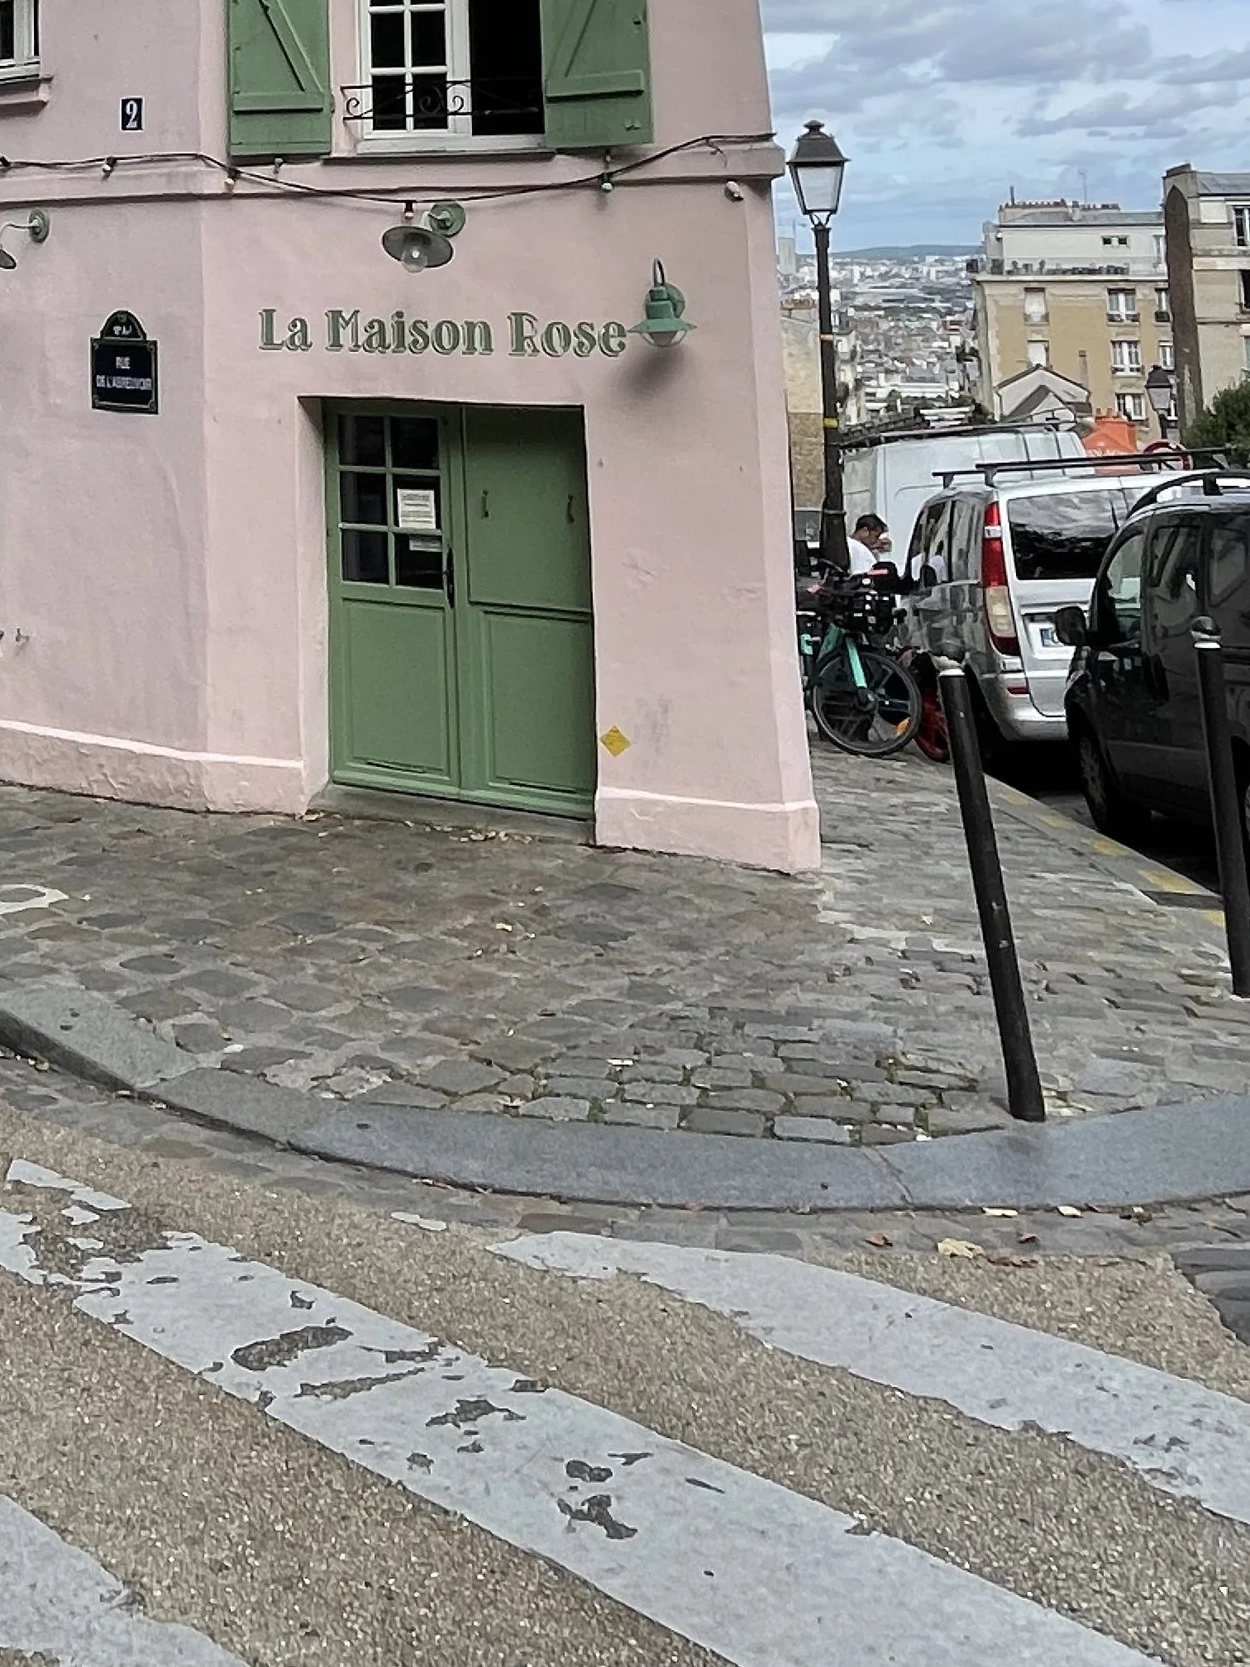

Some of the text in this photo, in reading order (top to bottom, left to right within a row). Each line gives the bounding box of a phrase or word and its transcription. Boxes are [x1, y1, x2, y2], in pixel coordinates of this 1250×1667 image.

[125, 100, 138, 128] 2
[258, 309, 627, 358] La Maison Rose
